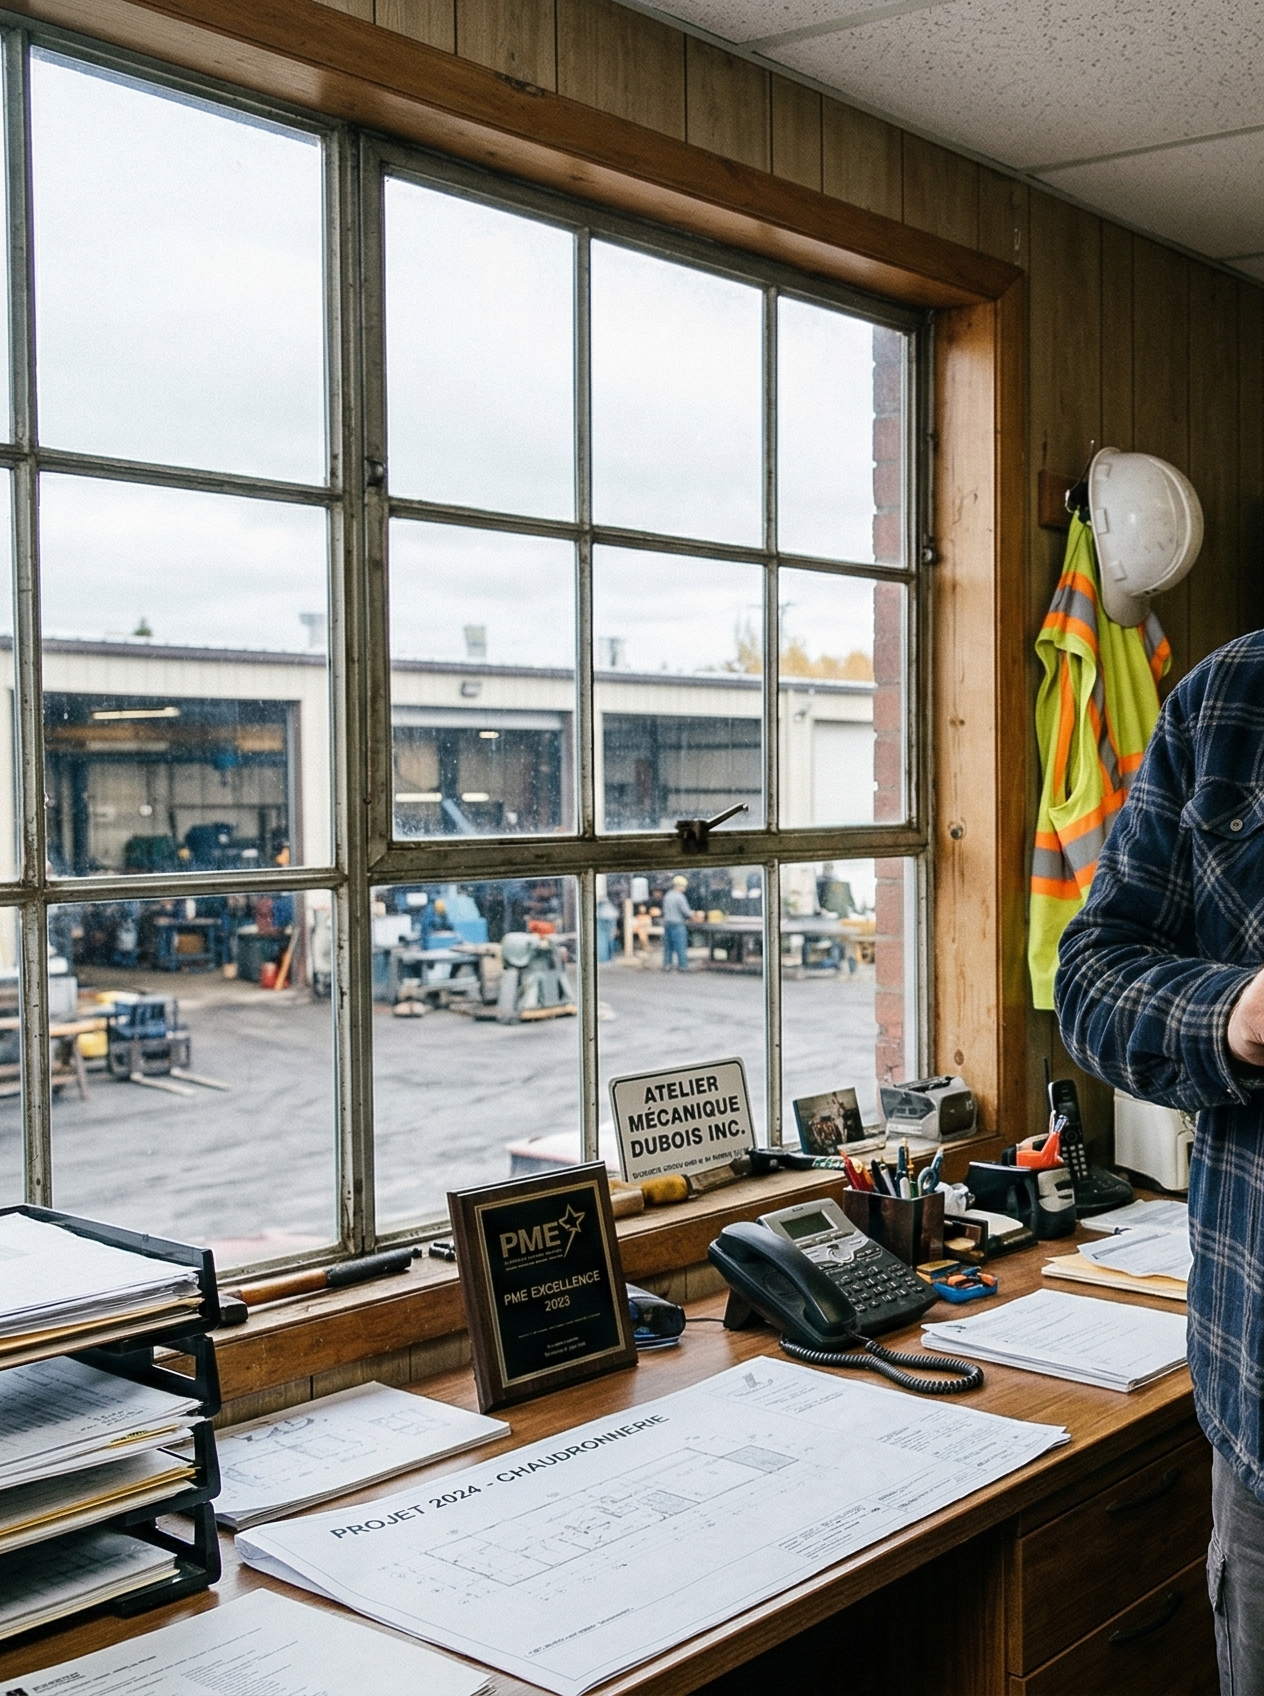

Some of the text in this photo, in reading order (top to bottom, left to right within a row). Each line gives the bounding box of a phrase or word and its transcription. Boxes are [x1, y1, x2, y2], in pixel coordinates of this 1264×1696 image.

[644, 1075, 719, 1104] ATELIER
[627, 1095, 741, 1133] MÉCANIQUE
[630, 1119, 746, 1158] DUBOIS INC.
[499, 1221, 561, 1259] PME
[504, 1269, 601, 1306] PME EXCELLENCE
[544, 1295, 571, 1312] 2023
[329, 1504, 426, 1539] PROJET
[429, 1485, 482, 1509] 2024
